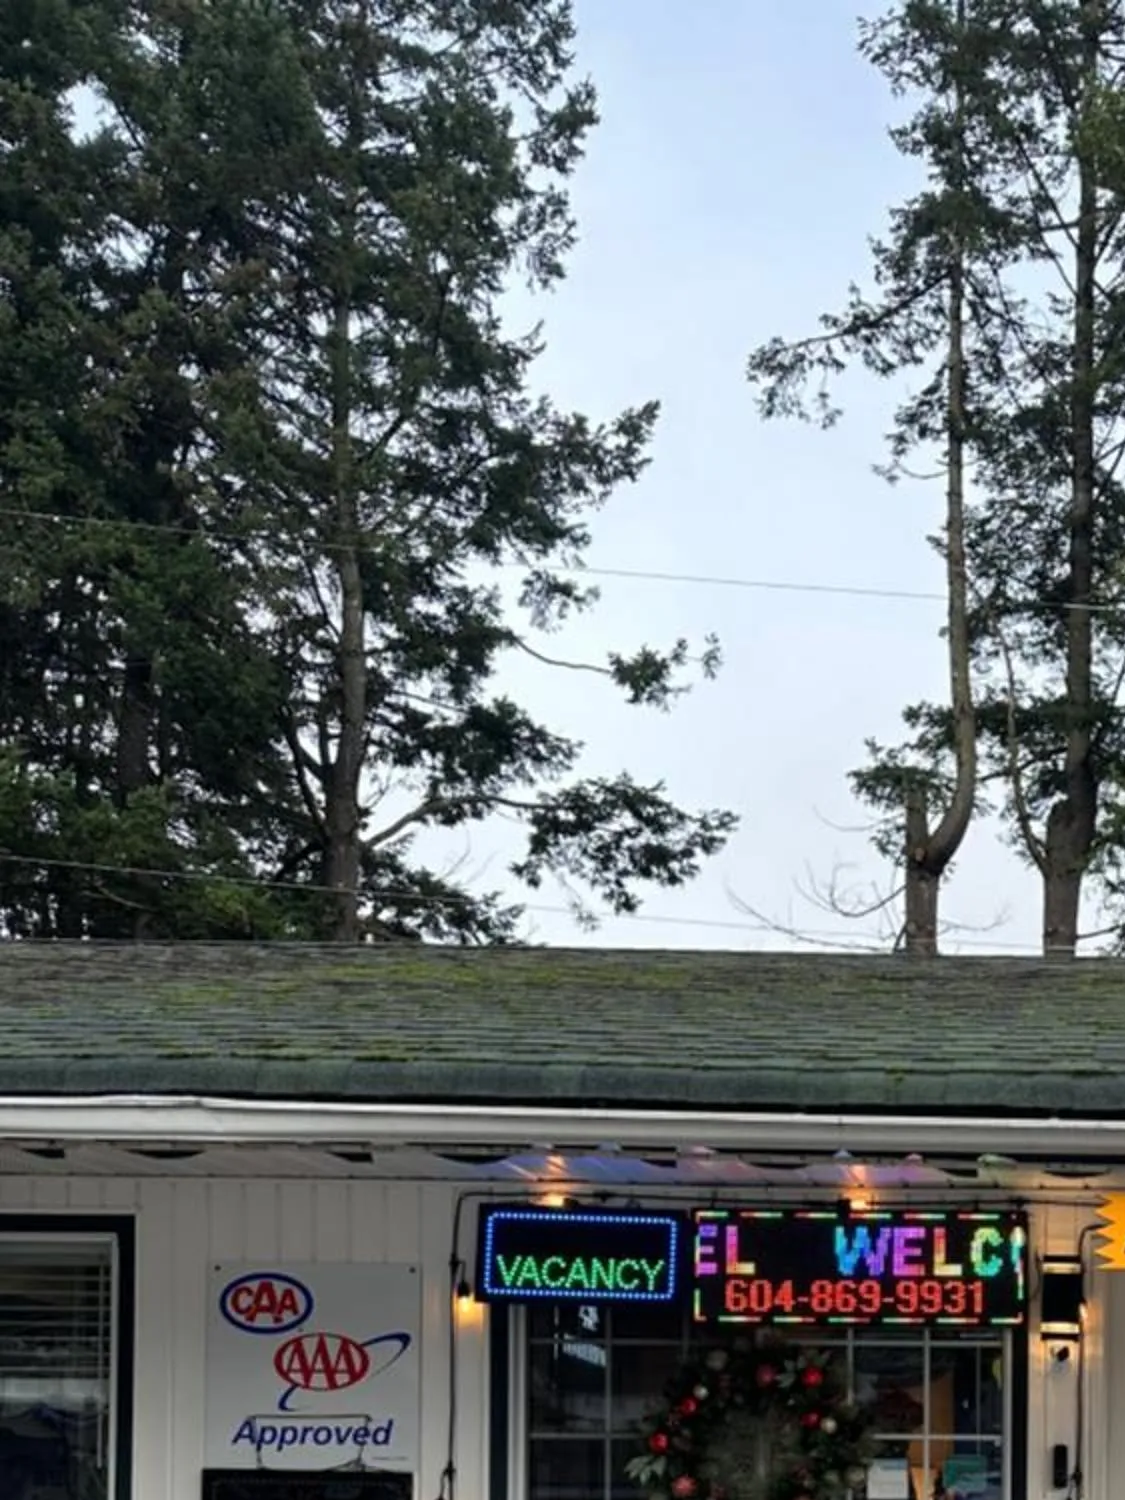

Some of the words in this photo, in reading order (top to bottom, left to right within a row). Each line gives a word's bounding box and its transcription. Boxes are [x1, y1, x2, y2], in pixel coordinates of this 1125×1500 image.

[496, 1254, 665, 1291] VACANCY
[230, 1279, 299, 1323] CAA
[725, 1279, 984, 1313] 604-869-9931
[273, 1332, 370, 1391] AAA
[231, 1418, 394, 1452] Approved
